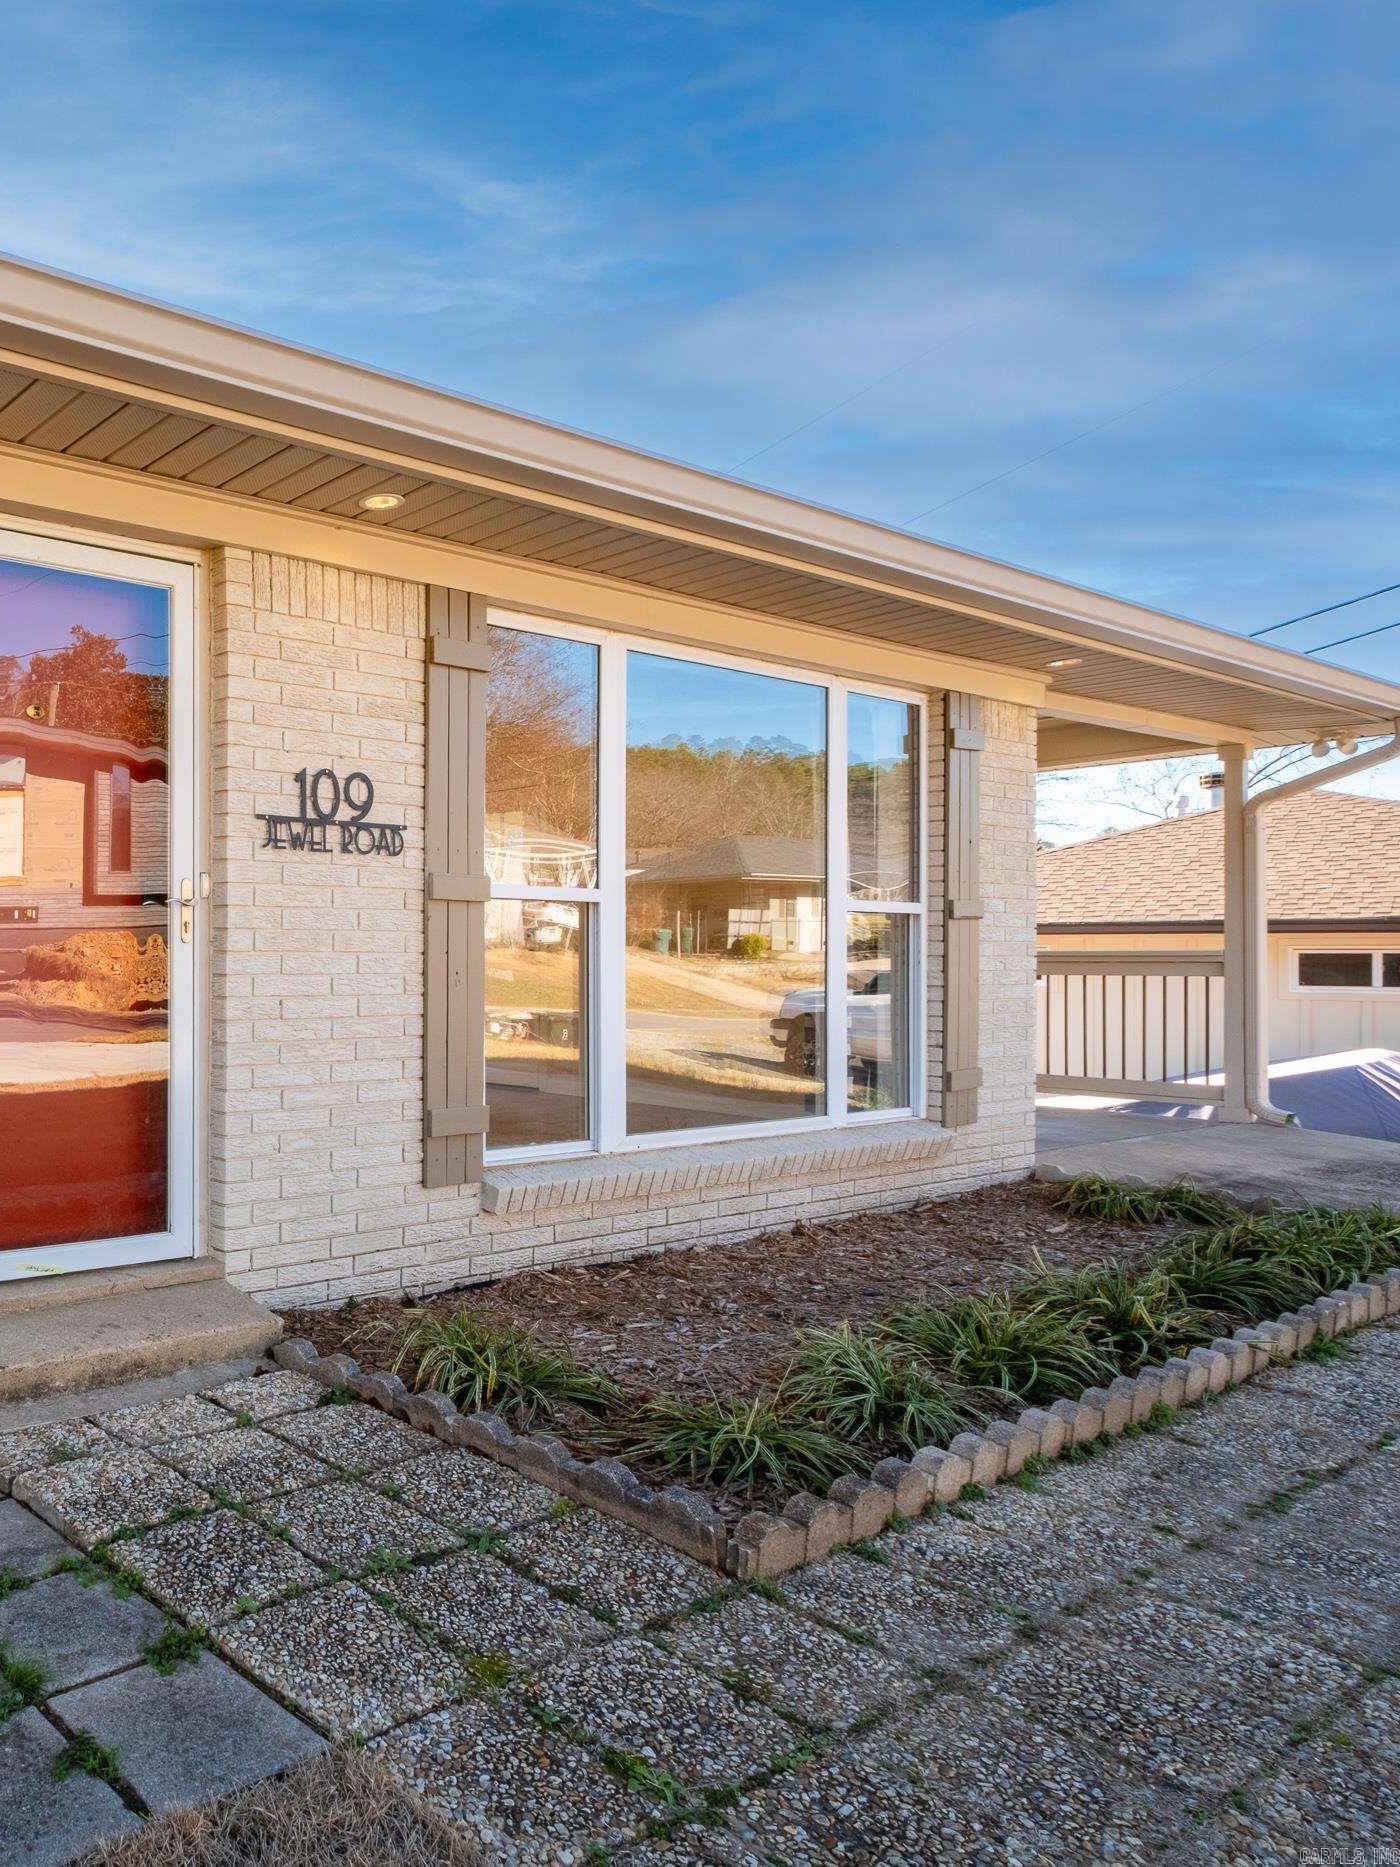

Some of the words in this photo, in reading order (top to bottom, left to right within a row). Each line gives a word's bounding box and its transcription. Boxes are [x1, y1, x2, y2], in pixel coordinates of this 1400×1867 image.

[294, 767, 374, 822] 109
[262, 819, 333, 852] JEWEL
[340, 824, 405, 856] ROAD
